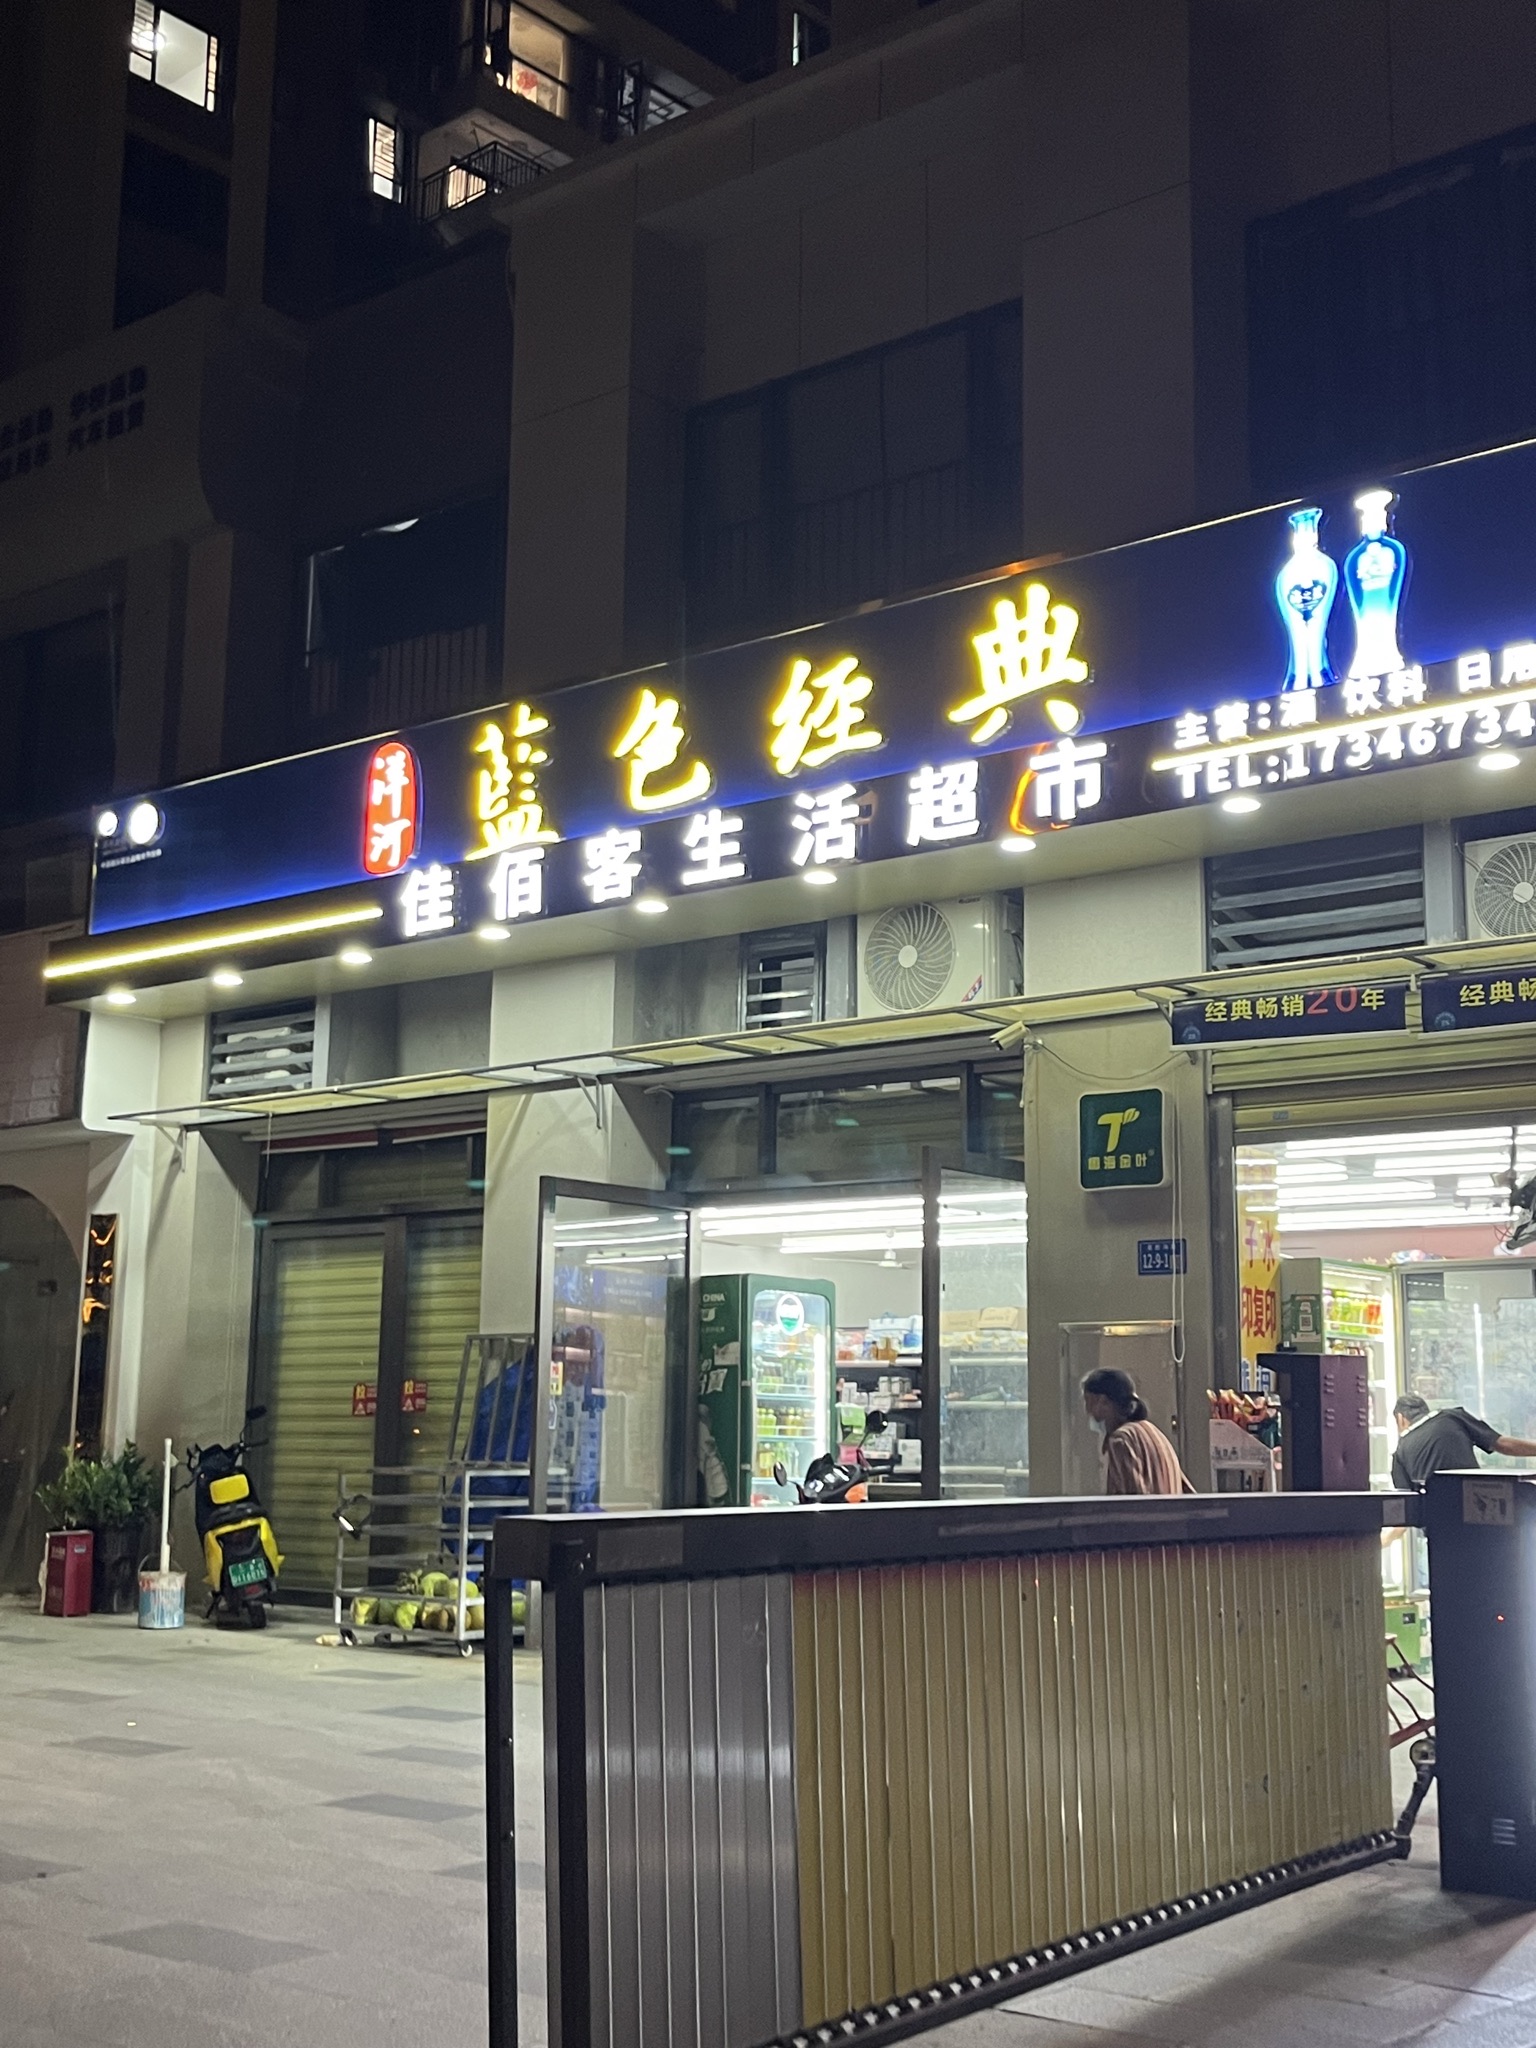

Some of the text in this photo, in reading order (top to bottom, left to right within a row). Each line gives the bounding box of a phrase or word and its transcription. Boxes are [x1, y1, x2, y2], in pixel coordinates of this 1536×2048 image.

[400, 738, 1108, 938] 佳佰客生活超市
[1204, 985, 1386, 1023] 经典畅销20年
